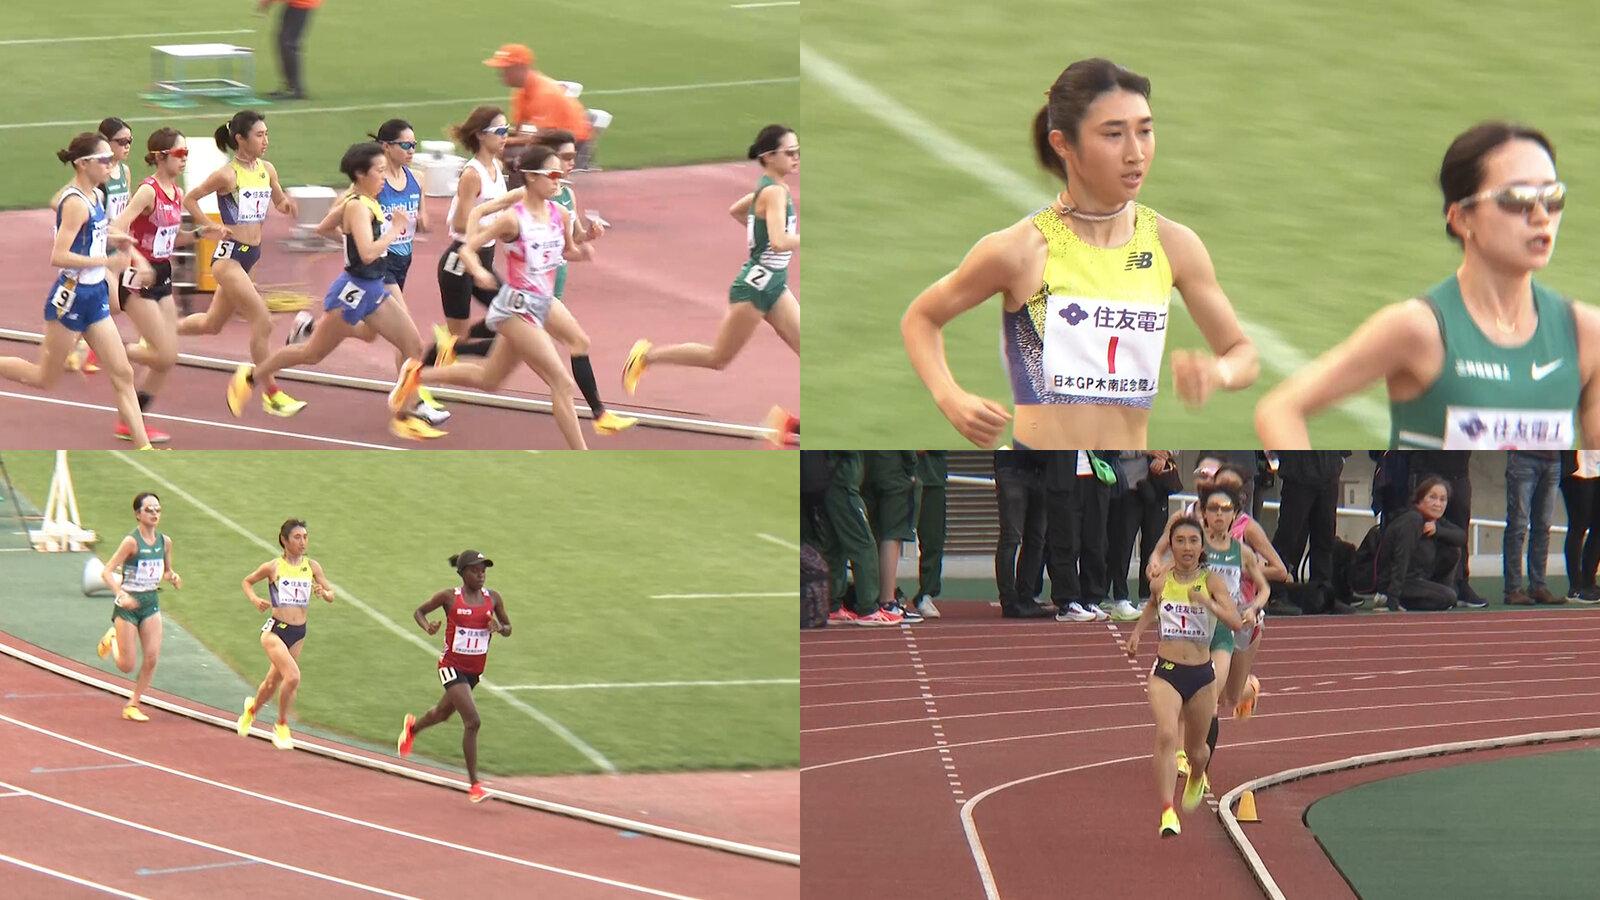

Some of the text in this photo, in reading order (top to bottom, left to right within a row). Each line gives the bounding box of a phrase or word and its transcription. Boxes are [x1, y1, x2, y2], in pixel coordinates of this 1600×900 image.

[218, 242, 230, 258] 5
[127, 268, 138, 286] 7
[751, 268, 766, 286] 2
[57, 291, 70, 308] 9
[345, 289, 360, 303] 6
[1107, 336, 1119, 374] 1
[1181, 615, 1186, 628] 1
[467, 638, 478, 649] 11
